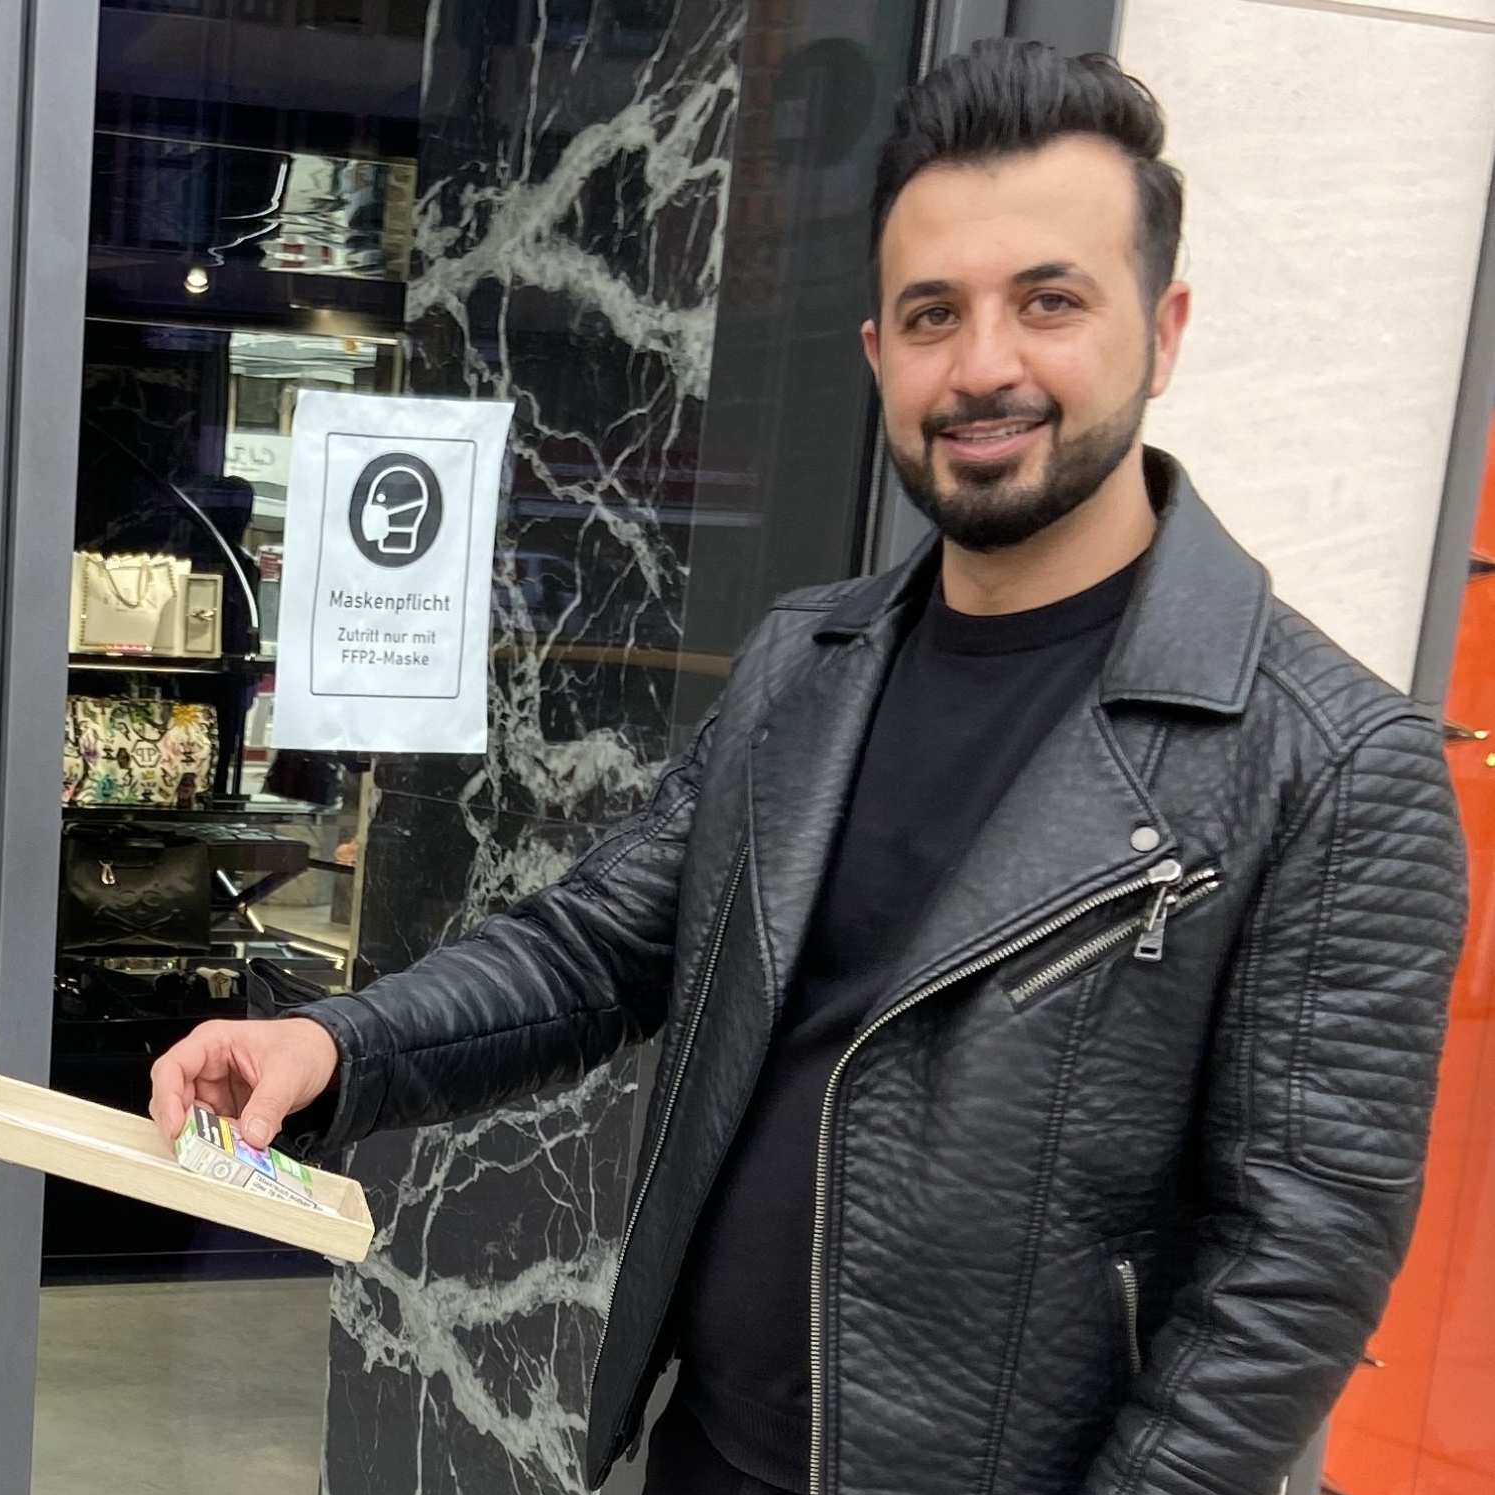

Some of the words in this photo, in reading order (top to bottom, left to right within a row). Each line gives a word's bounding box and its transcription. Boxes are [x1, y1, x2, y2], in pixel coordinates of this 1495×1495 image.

[329, 590, 451, 614] Maskenpflicht
[338, 627, 379, 643] Zutritt
[383, 632, 409, 644] nur
[412, 630, 437, 644] mit
[341, 649, 430, 666] FFP2-Maske
